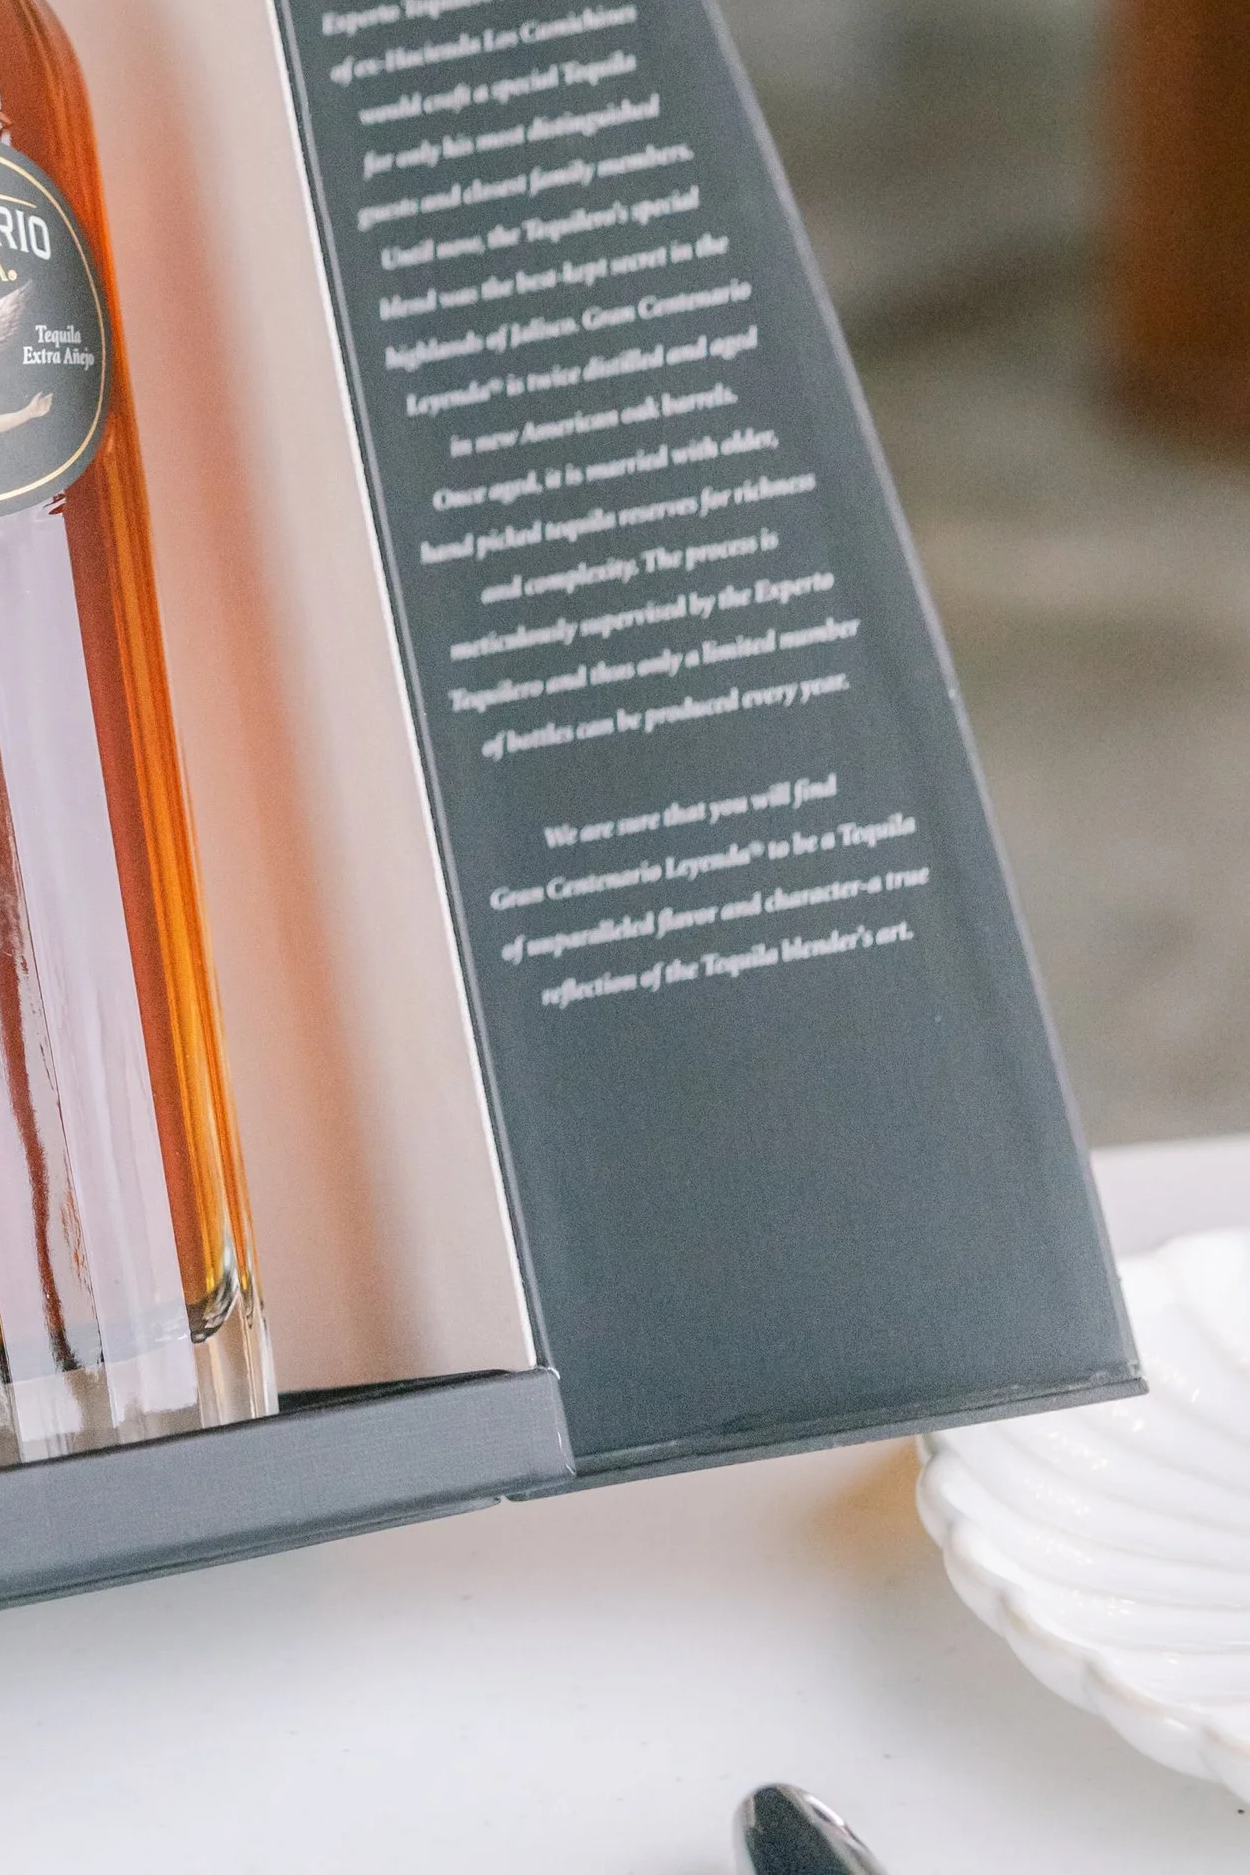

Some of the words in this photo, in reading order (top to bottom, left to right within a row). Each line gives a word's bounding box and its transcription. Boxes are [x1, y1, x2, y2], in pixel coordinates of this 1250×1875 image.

[22, 345, 61, 365] Extra
[63, 346, 95, 371] Añejo
[35, 324, 82, 348] Tequila
[450, 436, 472, 457] in
[475, 430, 518, 451] new
[520, 409, 618, 442] American
[620, 396, 659, 423] oak
[432, 487, 486, 510] Once
[545, 469, 561, 488] it
[565, 464, 583, 484] is
[585, 444, 668, 481] married
[671, 436, 718, 463] with
[420, 533, 473, 563] hand
[545, 508, 615, 541] tequila
[618, 497, 698, 525] reserves
[700, 486, 731, 516] for
[733, 473, 815, 504] richness
[481, 575, 521, 603] and
[641, 547, 682, 572] The
[685, 535, 757, 570] process
[760, 527, 778, 550] is
[450, 618, 577, 660] meticulously
[580, 594, 686, 637] supervised
[689, 592, 715, 618] by
[718, 585, 751, 609] the
[754, 572, 834, 604] Experto
[448, 679, 543, 712] Tequilero
[546, 665, 586, 693] and
[590, 661, 635, 684] thus
[636, 648, 682, 676] only
[684, 649, 699, 667] a
[702, 628, 775, 663] limited
[779, 616, 860, 649] number
[481, 731, 505, 760] of
[505, 722, 573, 752] bottles
[576, 718, 614, 738] can
[616, 709, 641, 731] be
[644, 687, 738, 732] produced
[741, 682, 798, 708] every
[544, 824, 577, 847] We
[580, 821, 613, 841] are
[617, 812, 660, 835] sure
[663, 801, 705, 826] that
[709, 796, 747, 823] you
[750, 781, 790, 809] will
[793, 772, 837, 808] find
[490, 887, 543, 909] Gran
[546, 861, 661, 898] Centenario
[767, 840, 789, 859] to
[792, 831, 817, 854] be
[820, 832, 835, 849] a
[837, 812, 916, 847] Tequila
[501, 935, 524, 964] of
[527, 911, 654, 957] unparalleled
[657, 906, 717, 938] flavor
[720, 891, 761, 920] and
[885, 866, 929, 890] true
[542, 973, 636, 1008] reflection
[640, 962, 663, 991] of
[665, 959, 698, 982] the
[700, 943, 778, 977] Tequila
